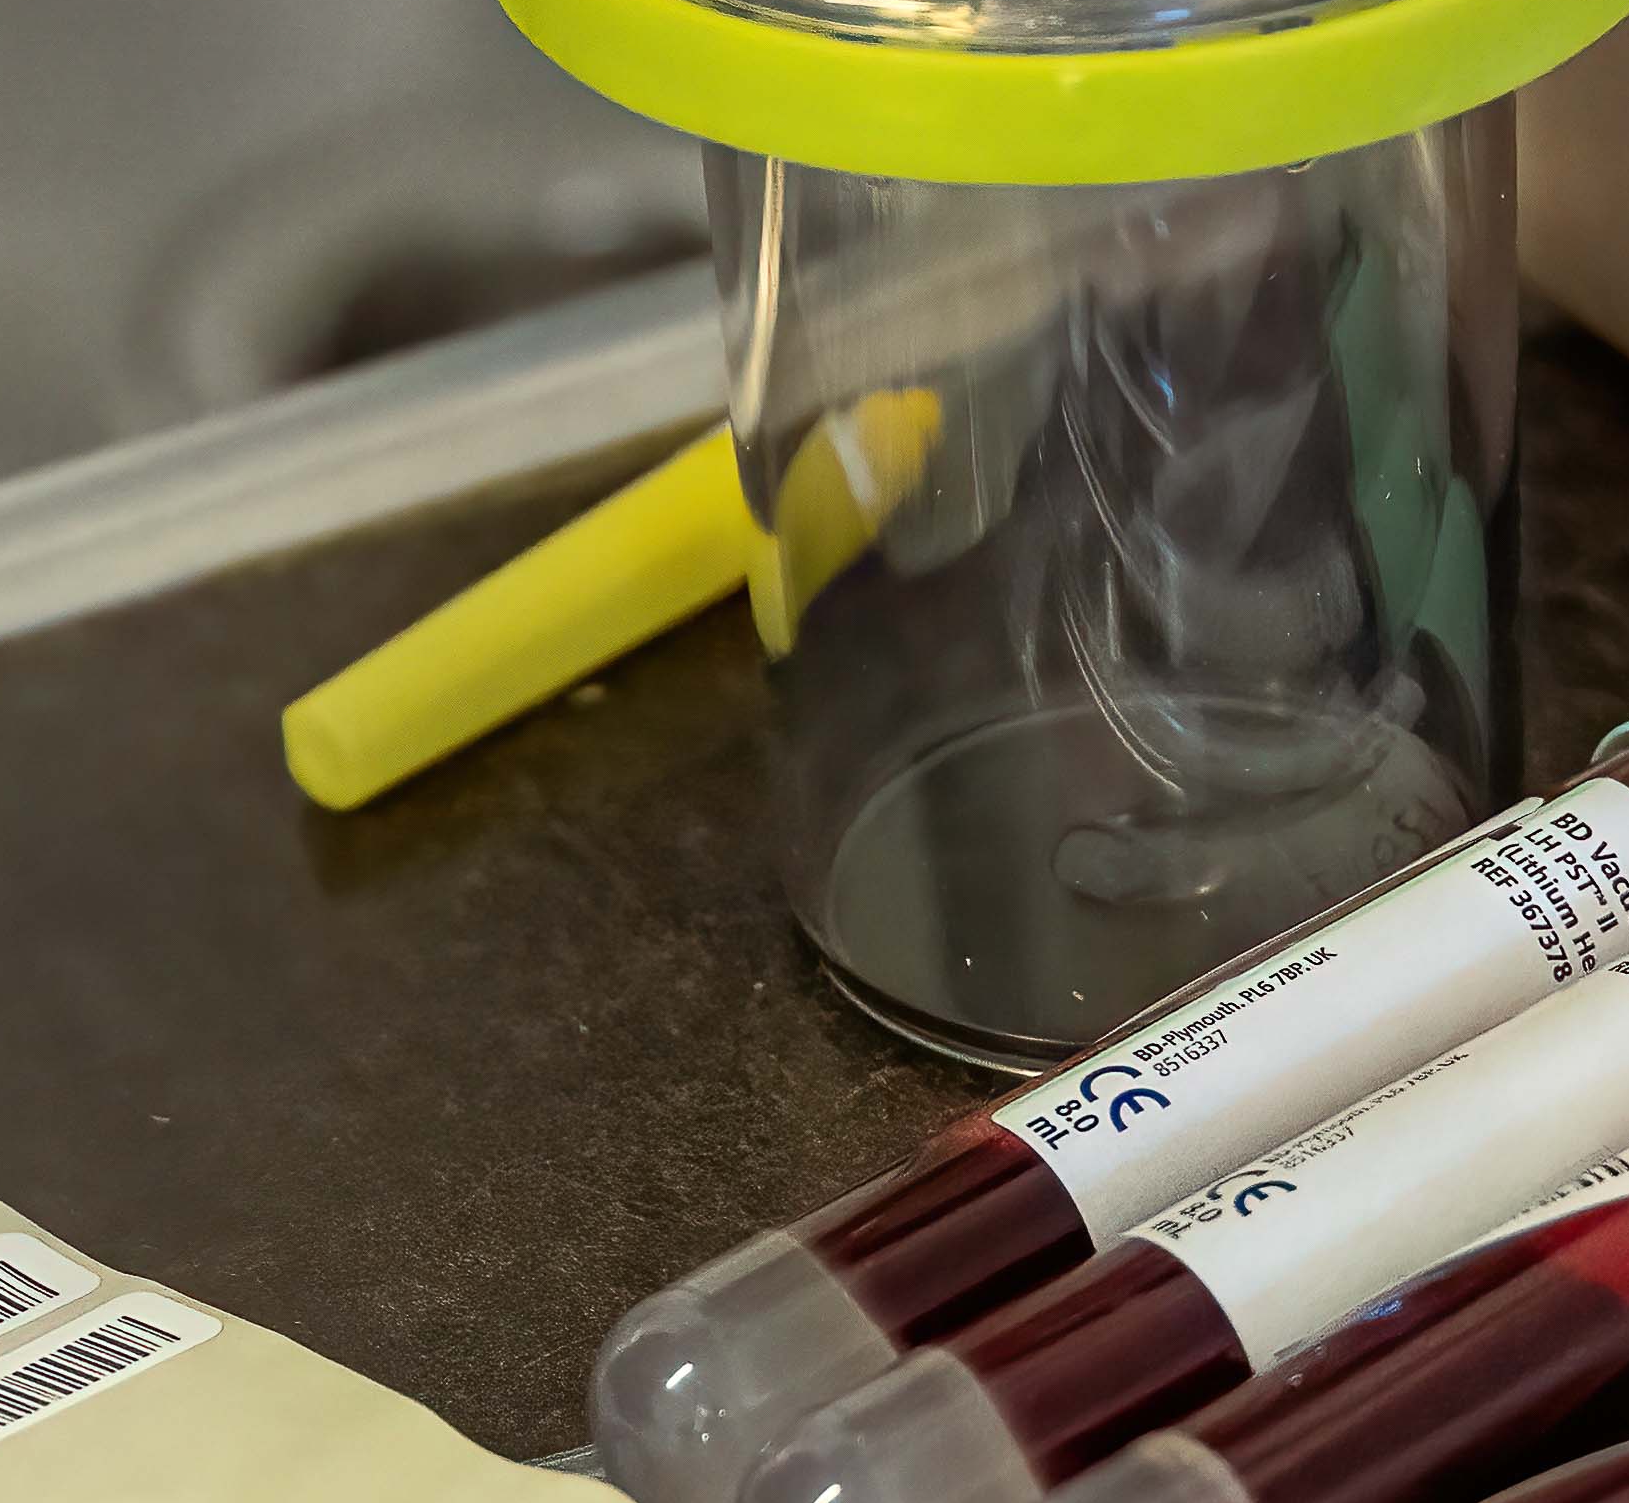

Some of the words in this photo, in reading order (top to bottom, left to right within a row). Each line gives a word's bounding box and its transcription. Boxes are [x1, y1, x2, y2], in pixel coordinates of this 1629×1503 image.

[1549, 811, 1594, 843] BD
[1496, 842, 1580, 930] (Lithium
[1524, 828, 1561, 853] LH
[1596, 910, 1620, 934] II
[1470, 857, 1519, 889] REF
[1509, 893, 1573, 984] 367378
[1238, 980, 1276, 1005] PL6
[1309, 945, 1338, 969] UK
[1151, 1028, 1229, 1078] 8516337
[1026, 1114, 1071, 1151] mL
[1054, 1098, 1100, 1133] 8.0
